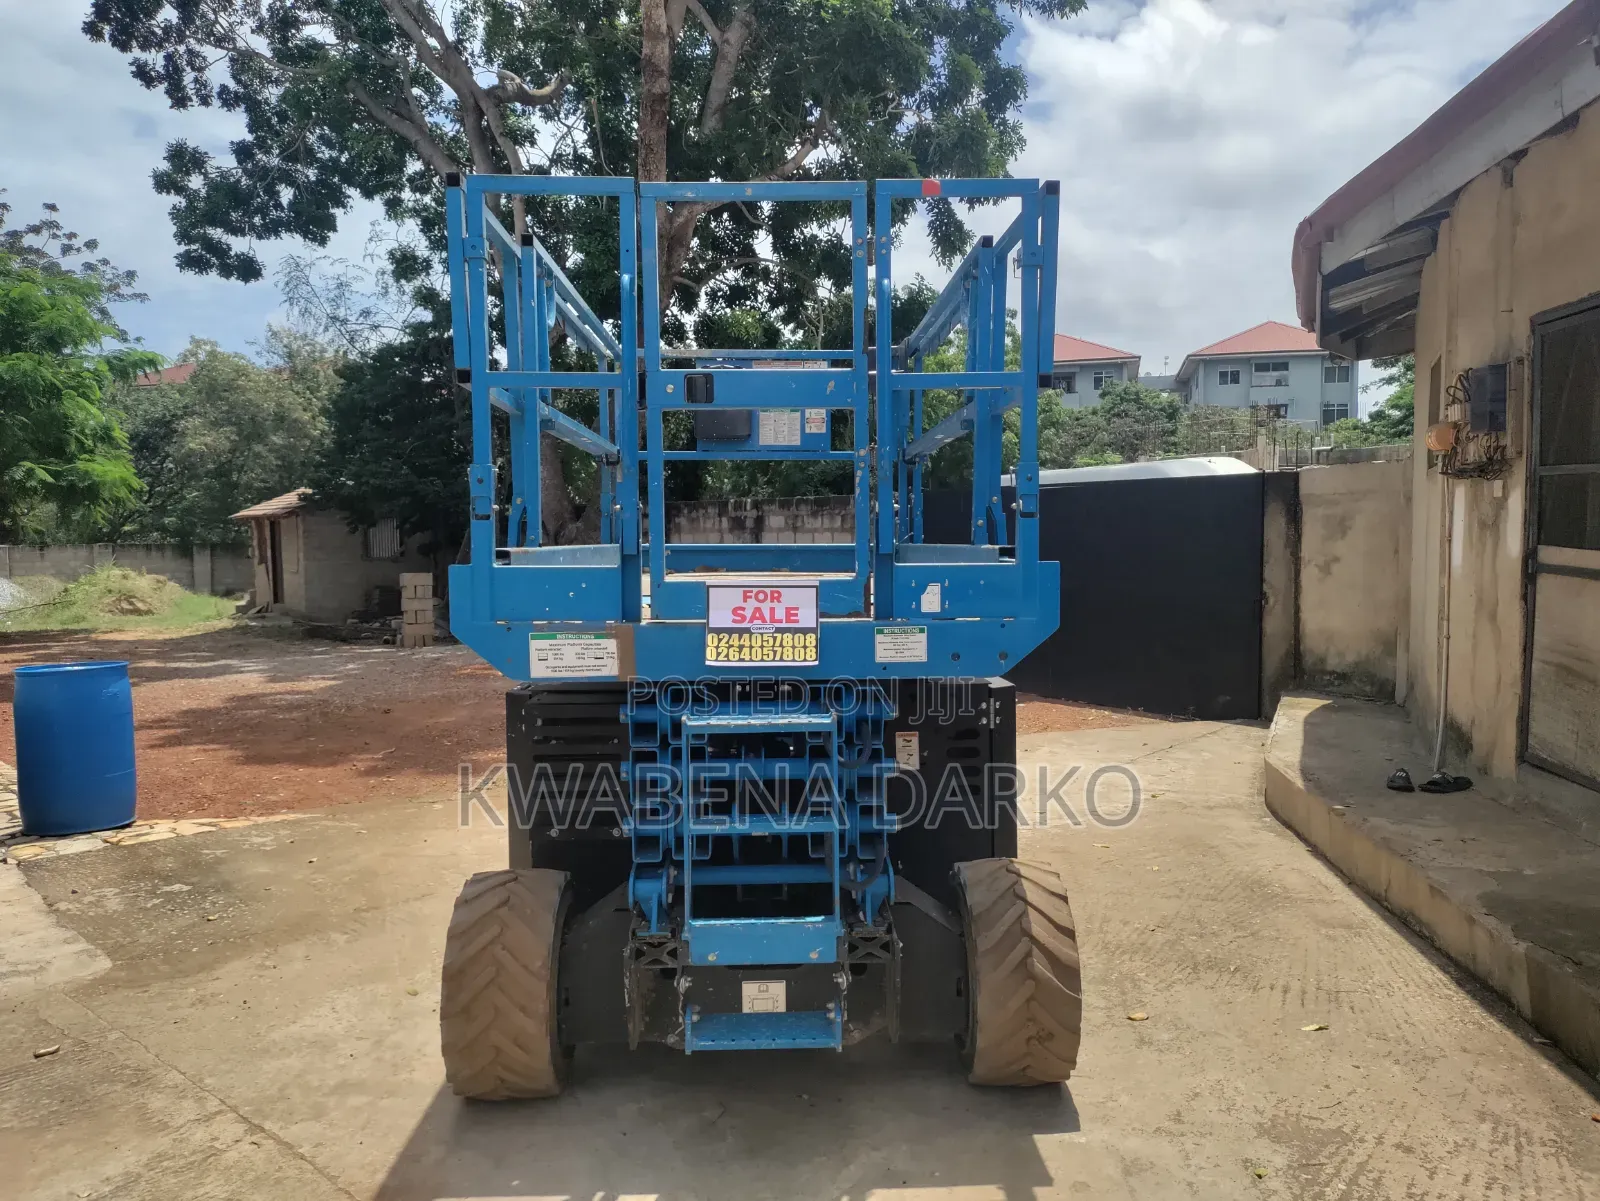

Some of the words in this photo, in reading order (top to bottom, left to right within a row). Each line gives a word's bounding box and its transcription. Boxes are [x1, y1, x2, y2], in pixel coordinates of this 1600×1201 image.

[742, 589, 783, 604] FOR
[731, 606, 800, 624] SALE
[707, 633, 817, 647] 0244057808
[706, 646, 817, 662] 0264057808
